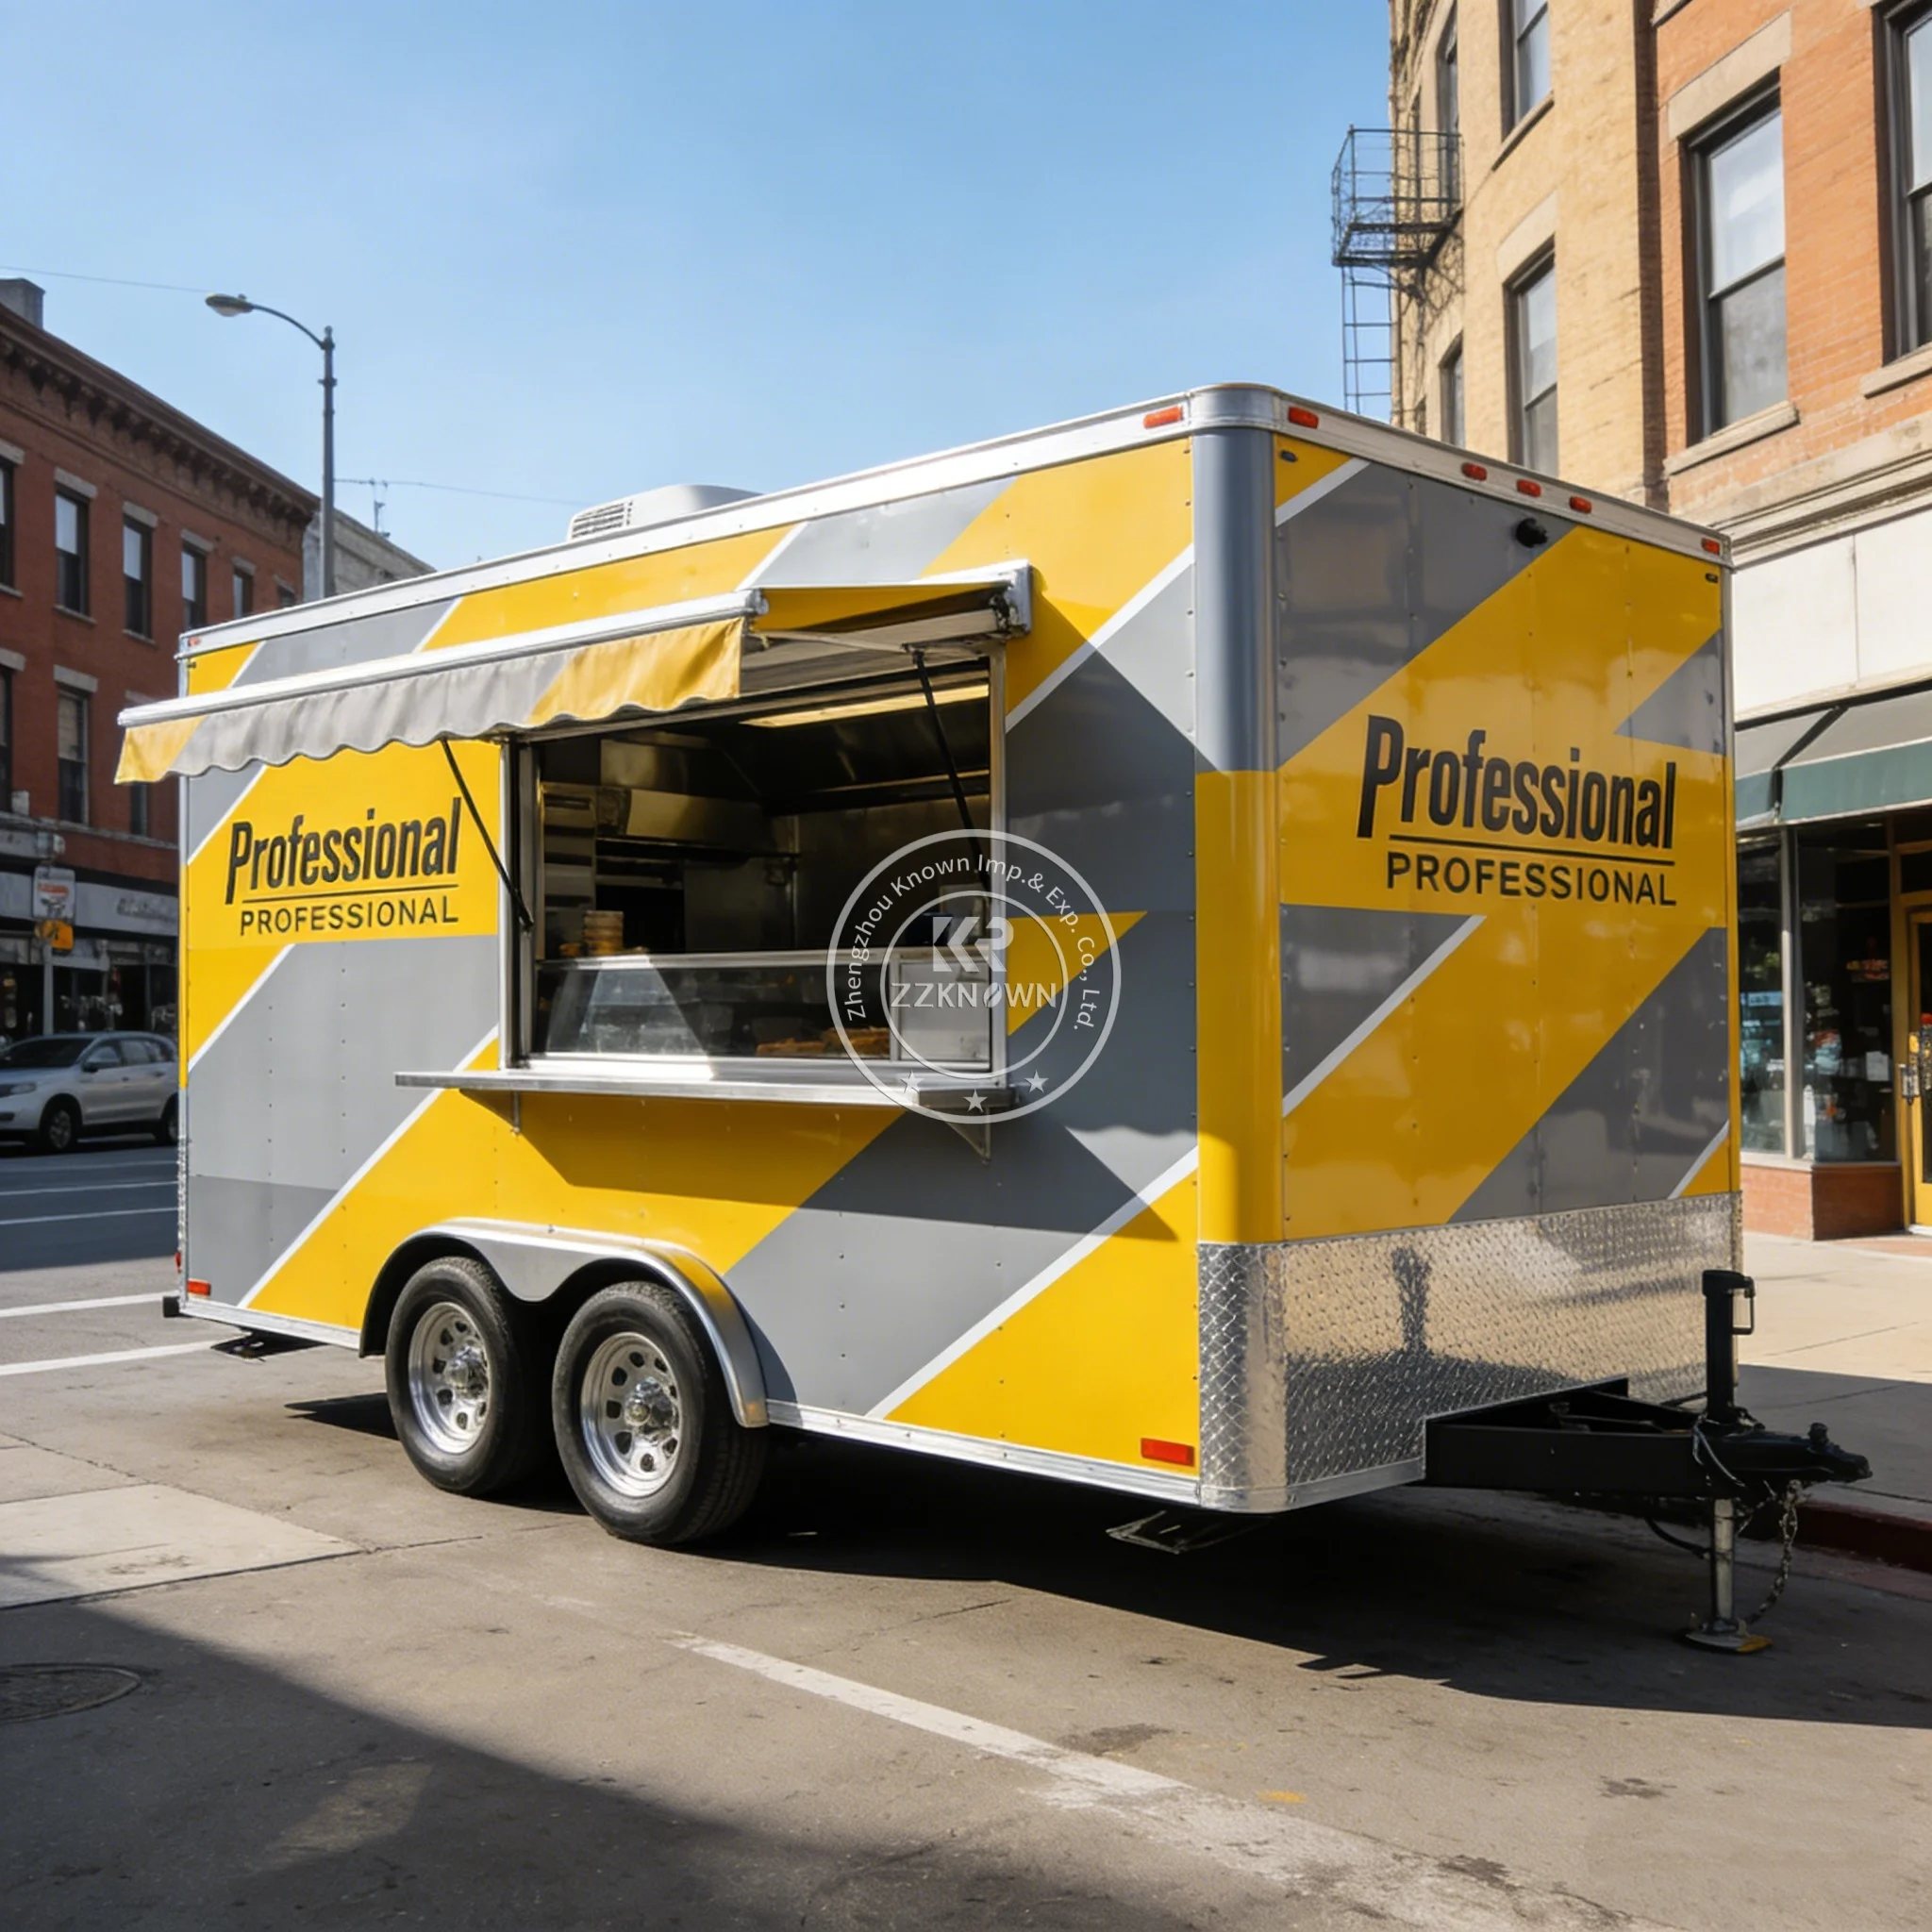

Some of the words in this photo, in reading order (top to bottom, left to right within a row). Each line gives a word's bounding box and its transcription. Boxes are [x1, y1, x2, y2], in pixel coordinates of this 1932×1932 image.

[1357, 714, 1676, 849] Professional
[225, 796, 461, 905] Professional
[1387, 851, 1676, 906] PROFESSIONAL
[241, 895, 458, 936] PROFESSIONAL
